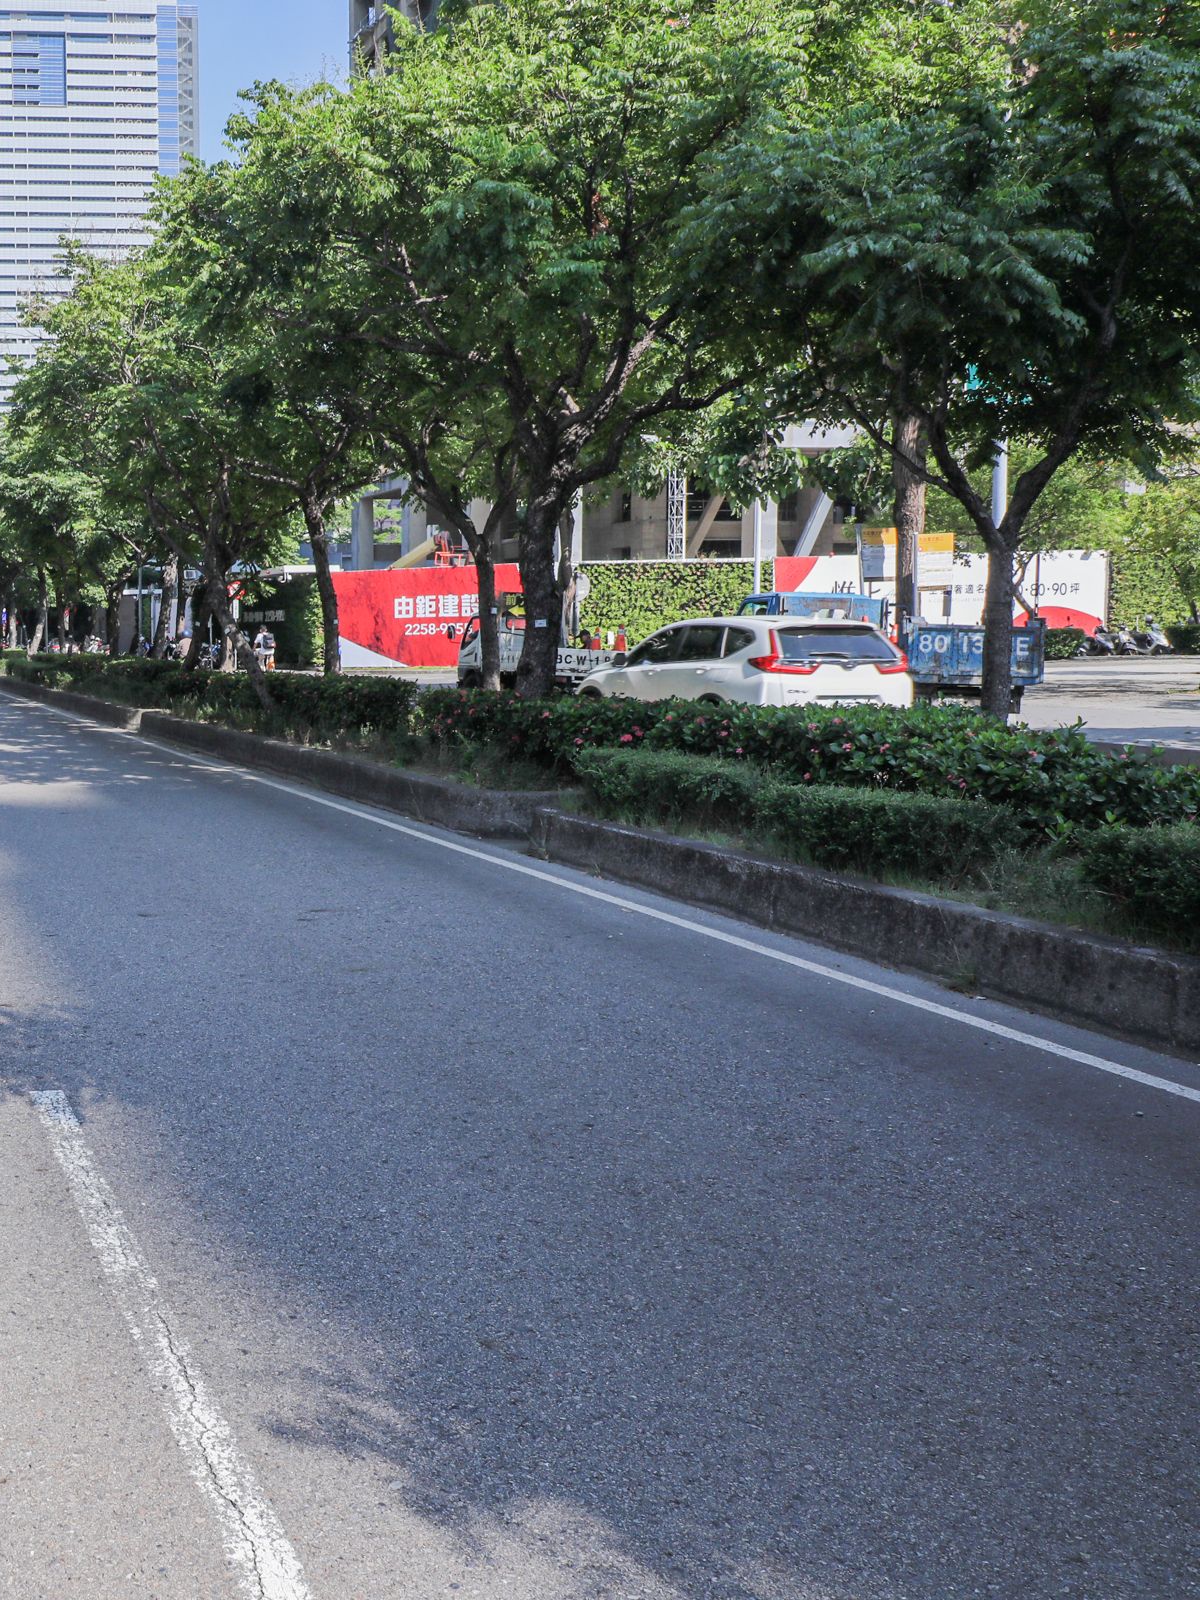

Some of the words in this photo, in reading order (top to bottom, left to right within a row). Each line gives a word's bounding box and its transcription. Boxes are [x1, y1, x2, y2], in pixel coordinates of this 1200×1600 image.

[394, 594, 479, 619] 由鉅建設
[919, 634, 949, 654] 80
